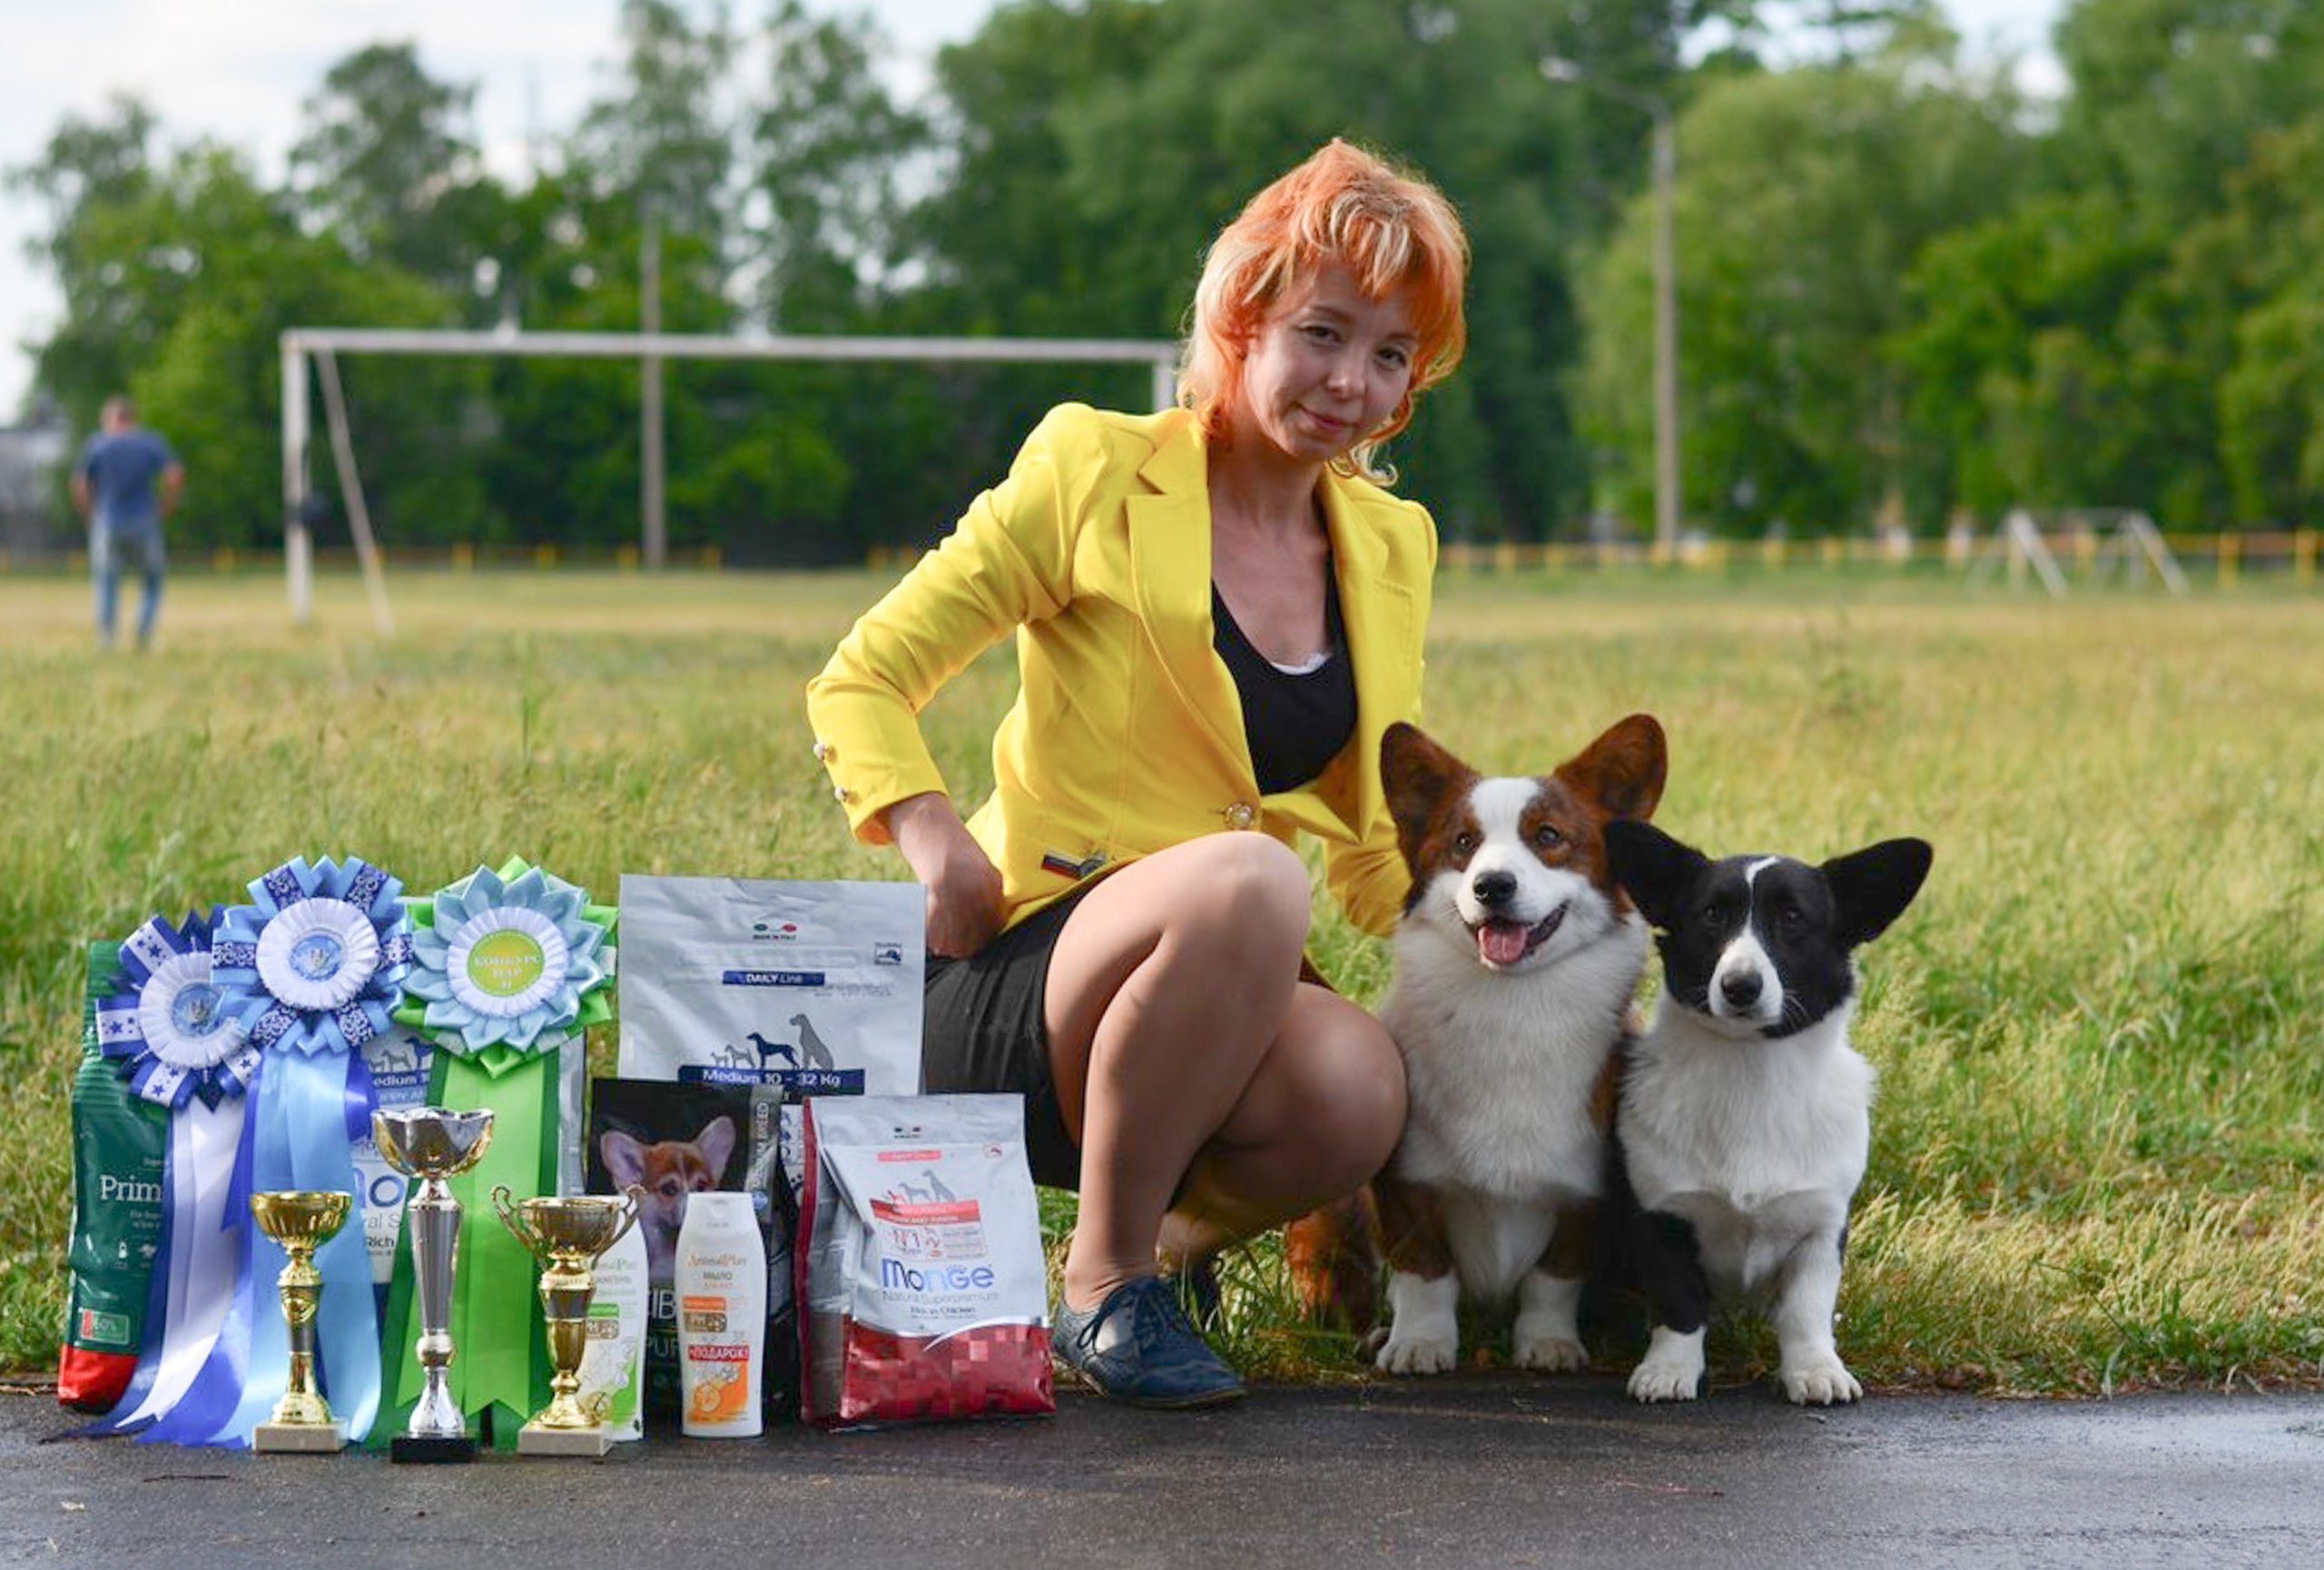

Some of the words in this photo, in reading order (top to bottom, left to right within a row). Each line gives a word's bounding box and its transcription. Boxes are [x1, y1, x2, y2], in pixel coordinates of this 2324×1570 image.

[746, 972, 777, 984] DAILY
[373, 1074, 418, 1087] edium
[703, 1070, 761, 1085] Medium
[764, 1072, 783, 1085] 10
[798, 1072, 818, 1085] 32
[820, 1073, 842, 1088] Kg
[99, 1173, 162, 1202] Prim
